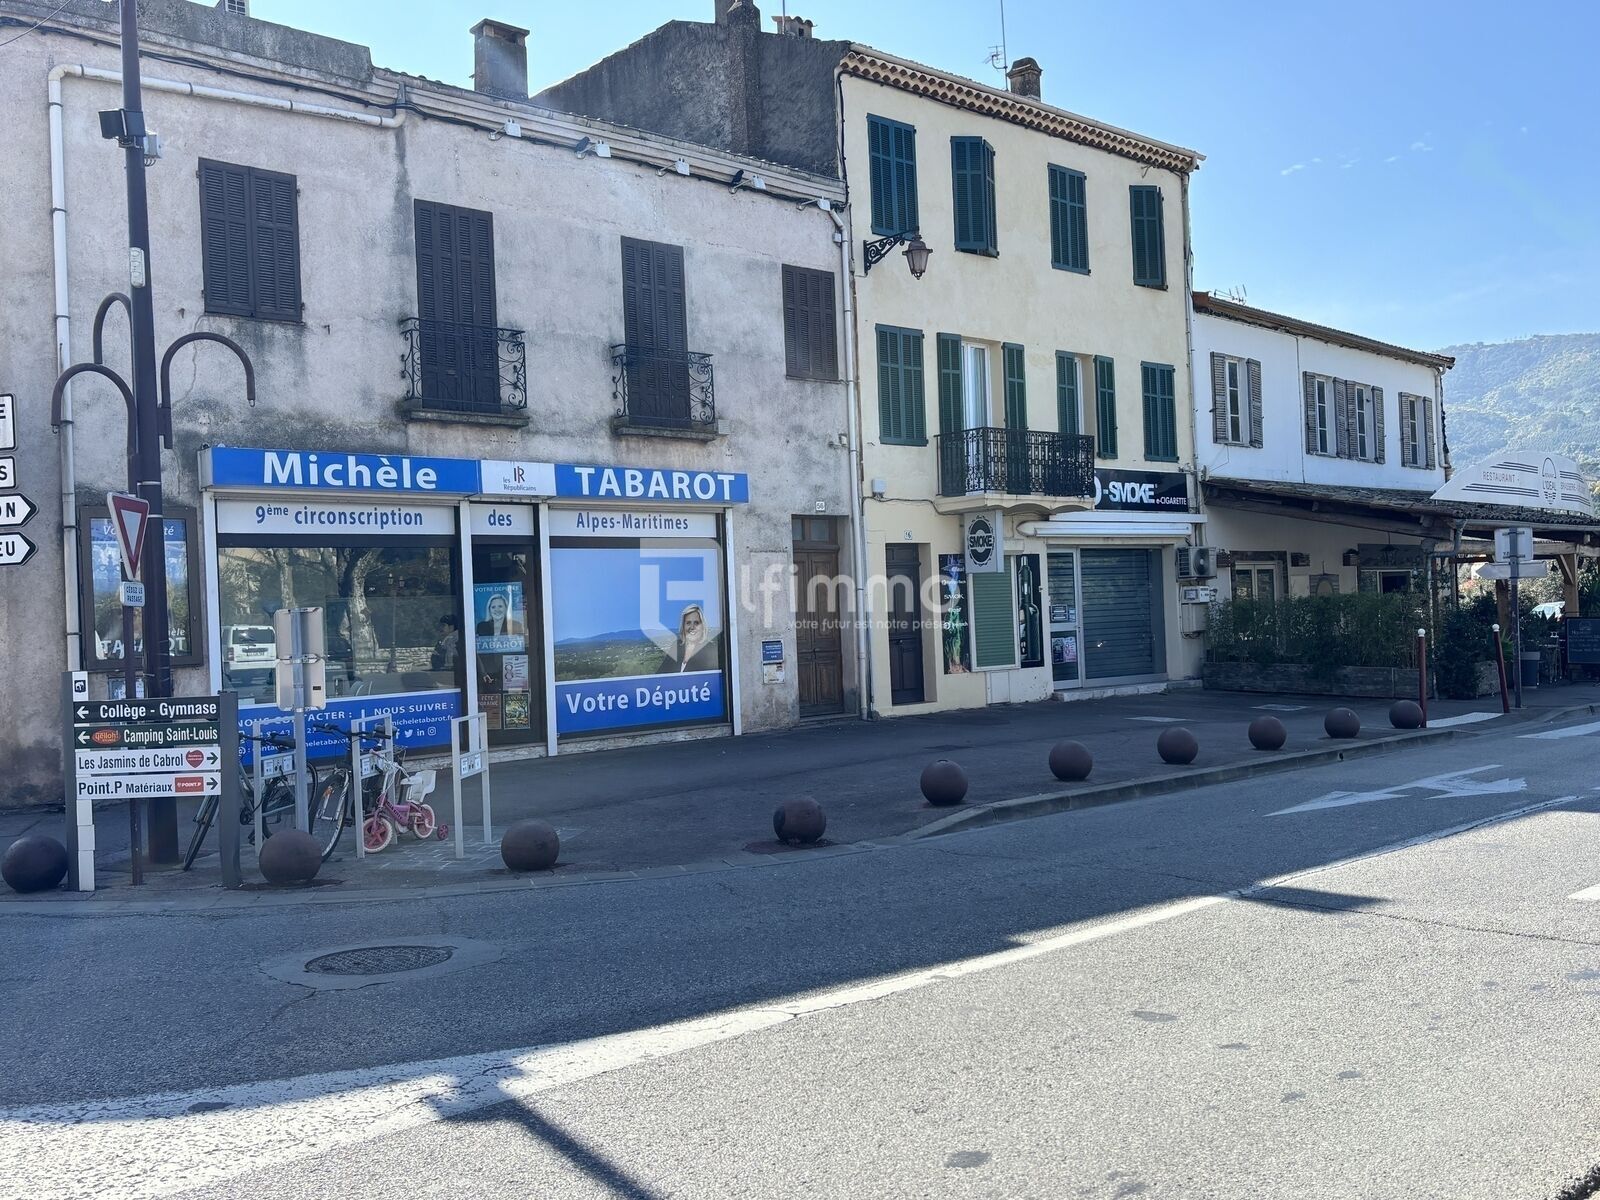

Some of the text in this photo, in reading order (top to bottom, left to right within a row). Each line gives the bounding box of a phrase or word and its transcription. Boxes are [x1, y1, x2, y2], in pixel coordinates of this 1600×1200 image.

[263, 451, 438, 489] Michèle
[1482, 471, 1516, 483] RESTAURANT
[574, 466, 735, 501] TABAROT
[1156, 496, 1187, 506] e-CIGARETTE
[0, 502, 16, 518] N
[255, 503, 424, 529] 9ème circonscription
[487, 509, 513, 527] des
[576, 511, 689, 532] Alpes-Maritimes
[969, 534, 993, 549] SMOKE
[476, 640, 523, 650] TABAROT
[565, 681, 711, 714] Votre Député
[99, 704, 146, 720] Collège
[159, 702, 217, 718] Gymnase
[374, 705, 406, 716] NOUS
[408, 702, 448, 713] SUIVRE
[123, 729, 164, 745] Camping
[166, 726, 218, 741] Saint-Louis
[78, 756, 95, 770] Les
[97, 754, 137, 770] Jasmins
[139, 754, 150, 768] de
[153, 753, 184, 768] Cabrol
[78, 780, 123, 796] Point.P
[125, 782, 173, 794] Matériaux
